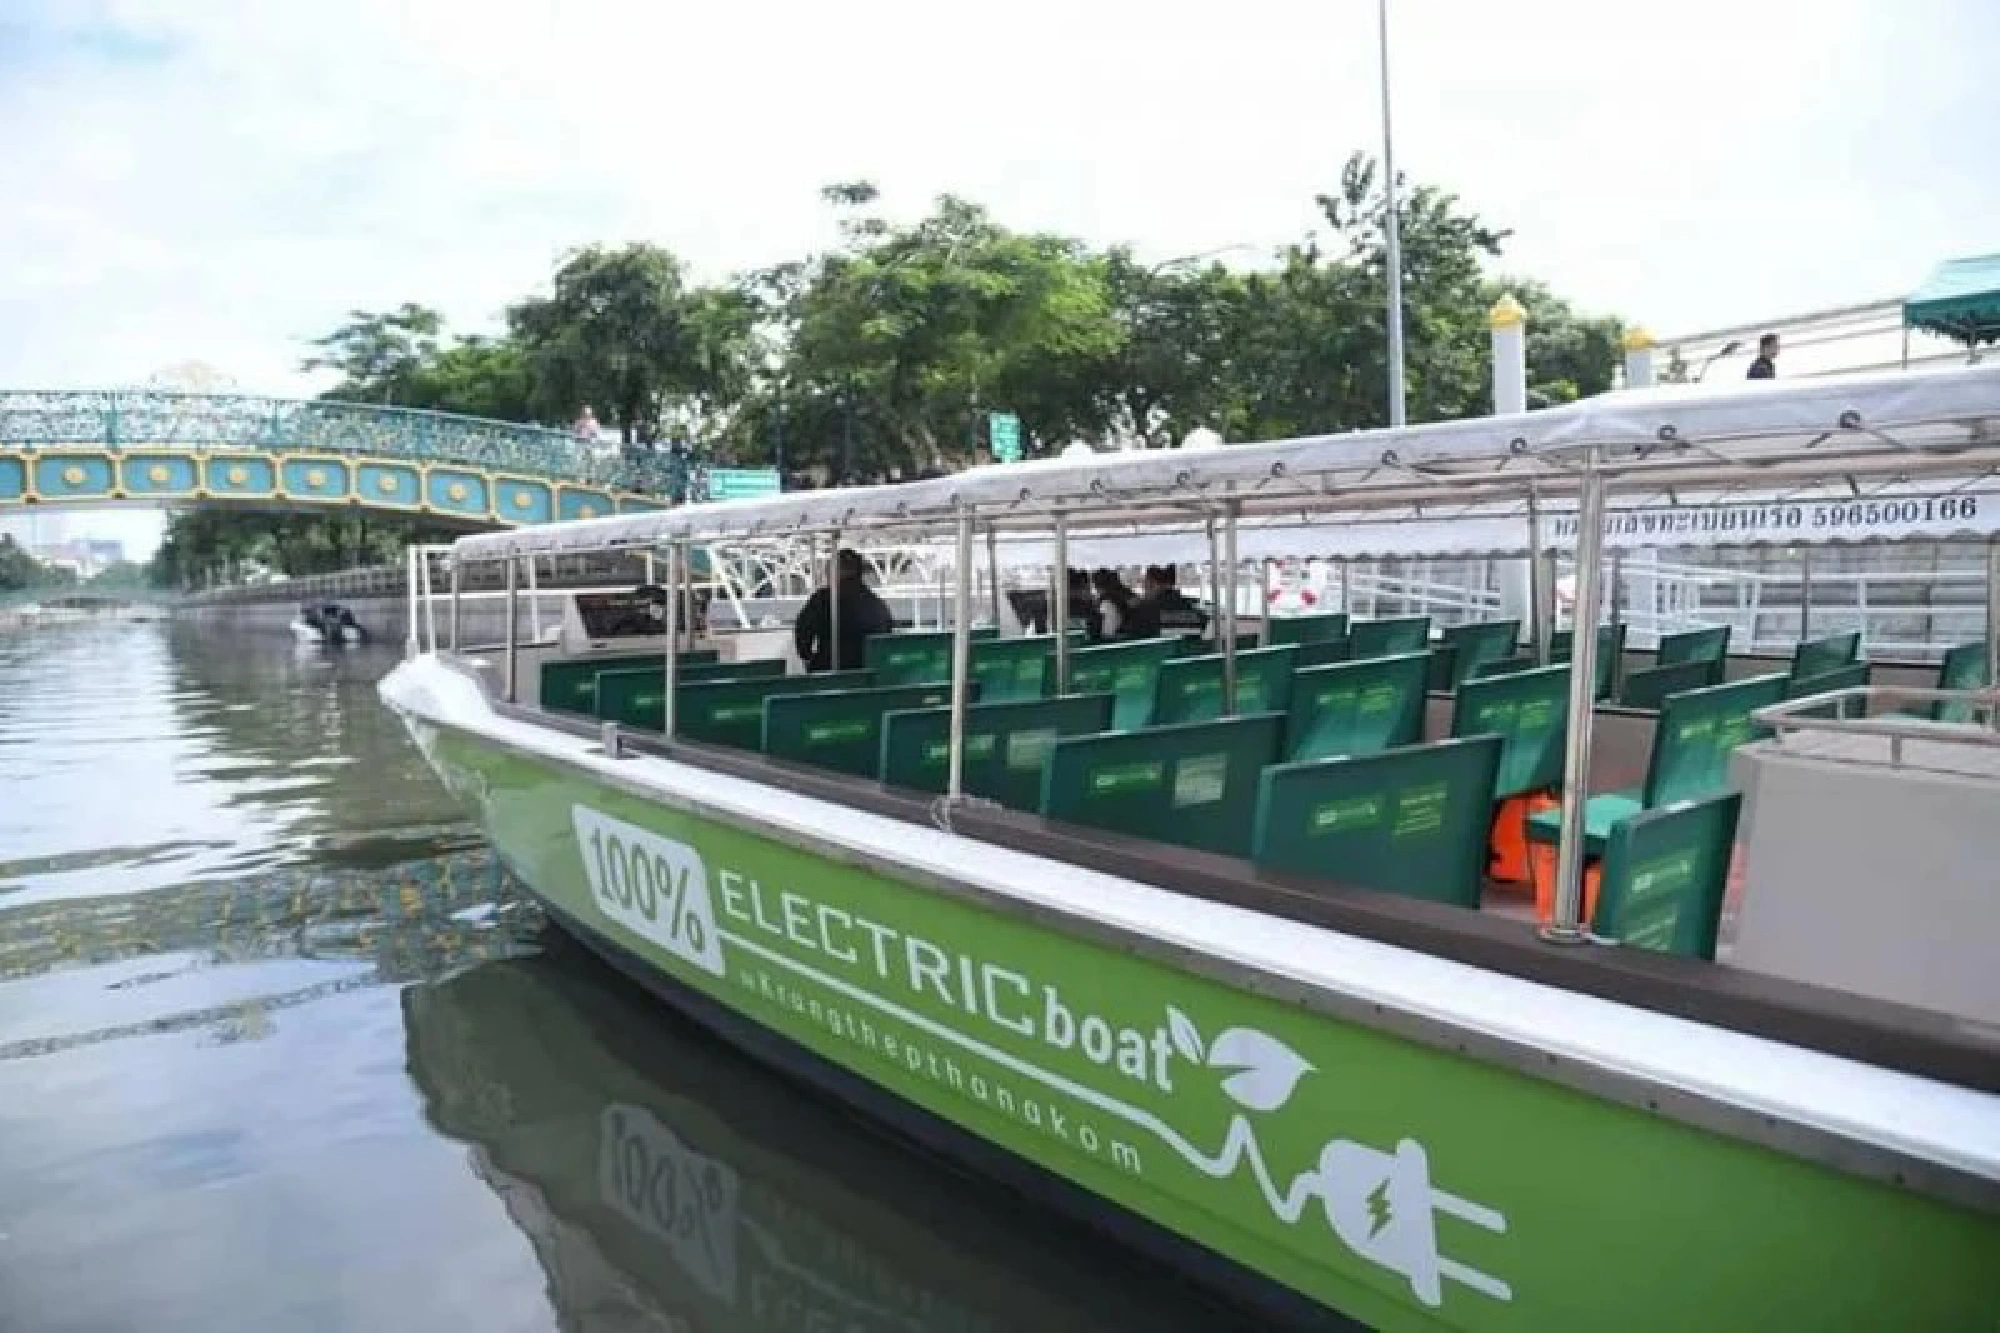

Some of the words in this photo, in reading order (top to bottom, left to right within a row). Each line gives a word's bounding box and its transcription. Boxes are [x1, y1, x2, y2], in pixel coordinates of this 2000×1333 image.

[1812, 498, 1976, 528] 596500166
[590, 827, 704, 954] 100%
[720, 869, 1034, 1036] ELECTRIC
[1043, 985, 1173, 1092] boat
